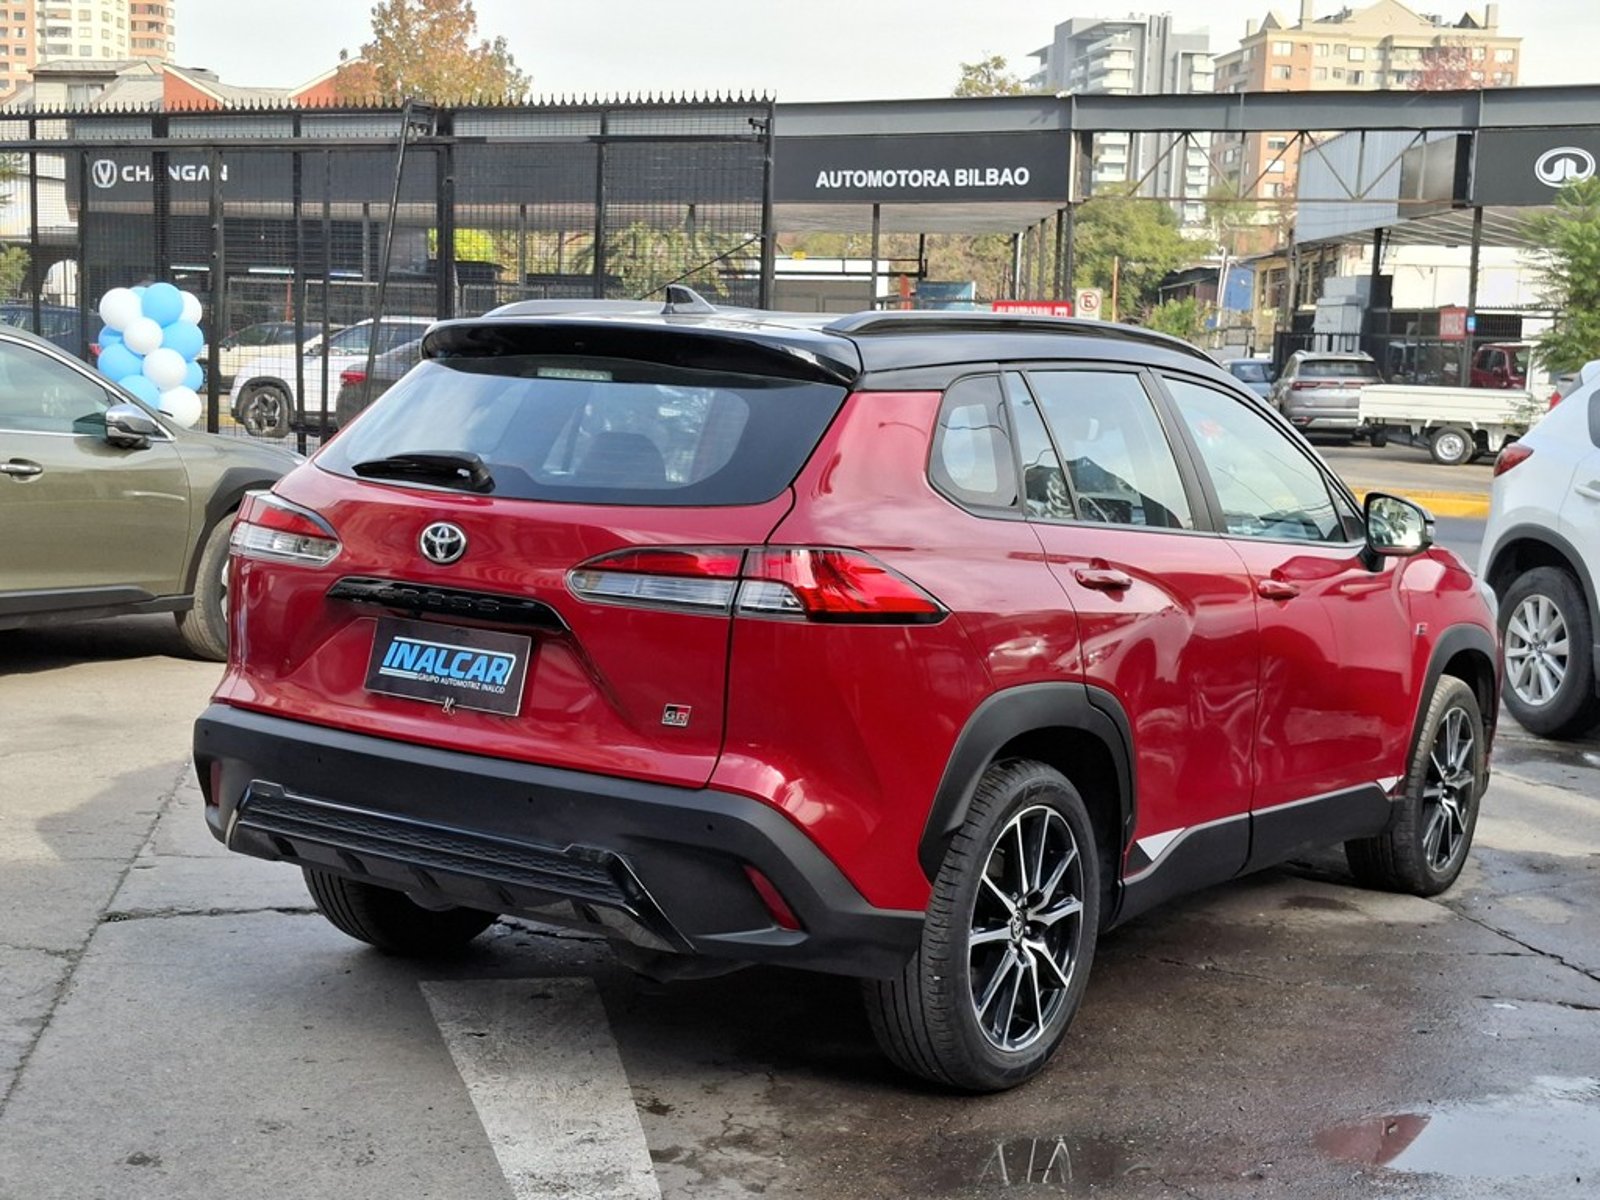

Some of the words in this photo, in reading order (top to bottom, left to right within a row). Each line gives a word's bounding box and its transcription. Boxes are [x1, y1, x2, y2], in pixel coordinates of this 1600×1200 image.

[121, 165, 228, 182] CHNGA
[815, 169, 951, 188] AUTOMOTORA
[954, 167, 1030, 187] BILBAO
[382, 641, 510, 685] INALCAR
[417, 672, 440, 684] GRUPO
[440, 677, 481, 690] AUTOMOTRIZ
